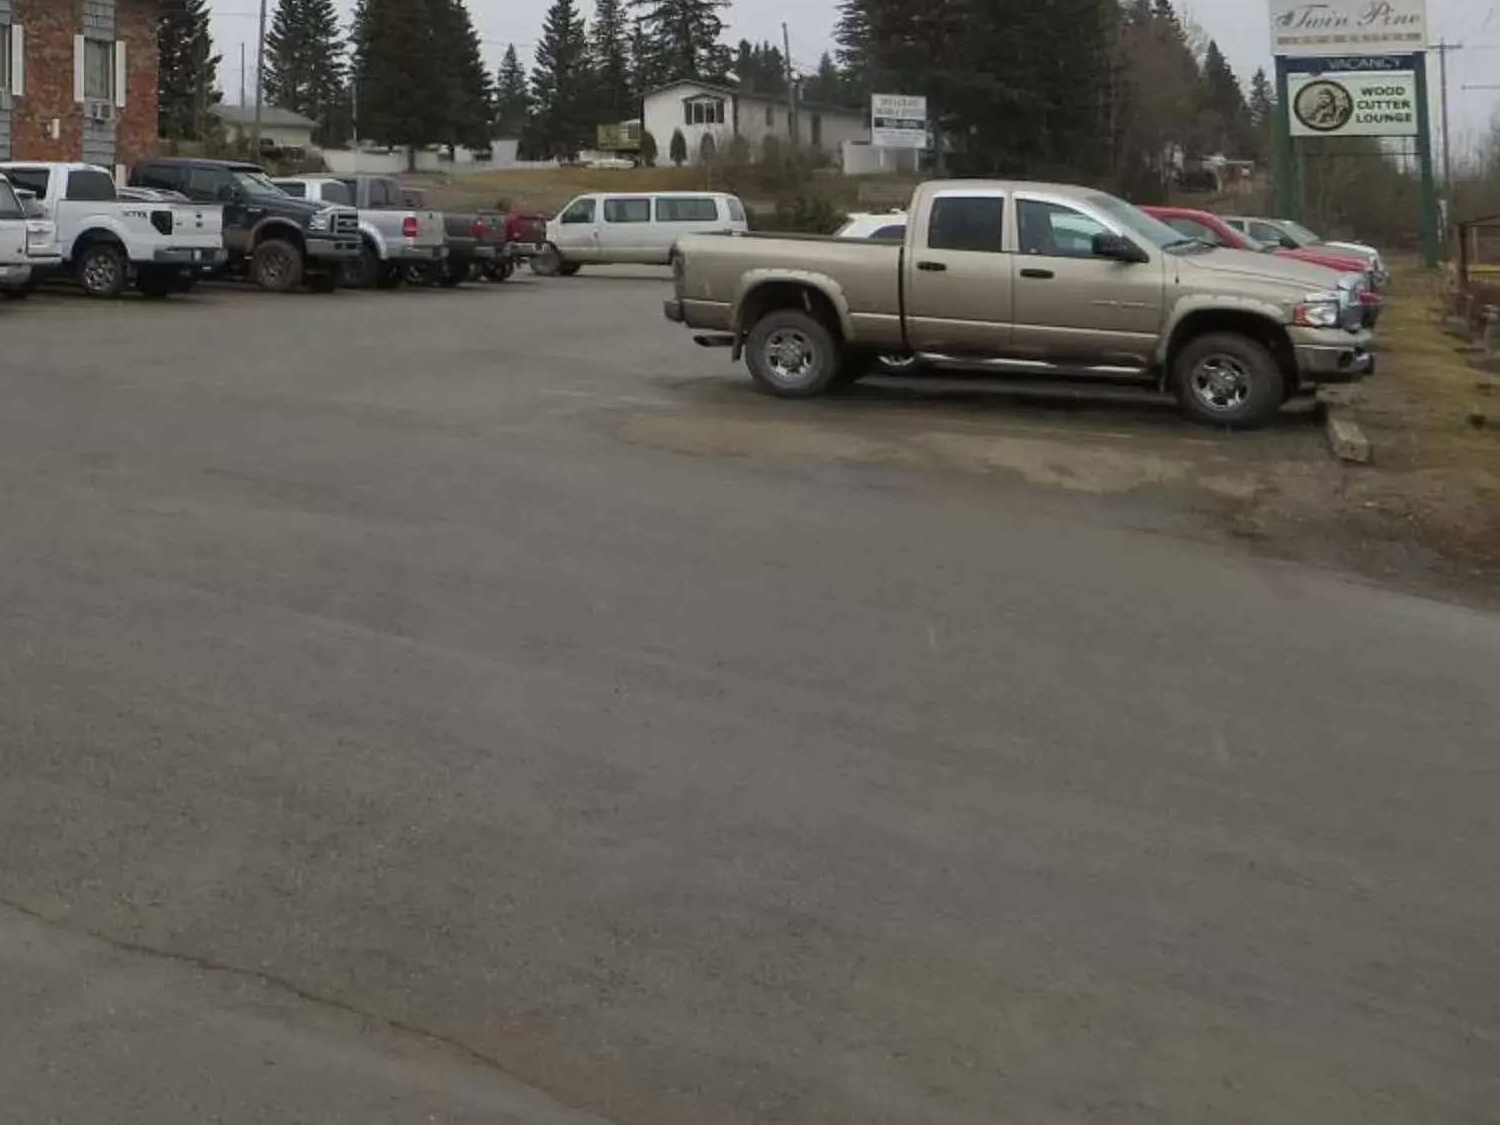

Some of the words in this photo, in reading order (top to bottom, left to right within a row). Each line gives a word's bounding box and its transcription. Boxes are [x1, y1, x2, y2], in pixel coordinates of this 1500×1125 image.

[1277, 4, 1349, 28] Twin
[1356, 0, 1420, 26] Pine
[1361, 86, 1406, 96] WOOD
[1357, 100, 1411, 110] CUTTER
[1356, 113, 1412, 123] LOUNGE
